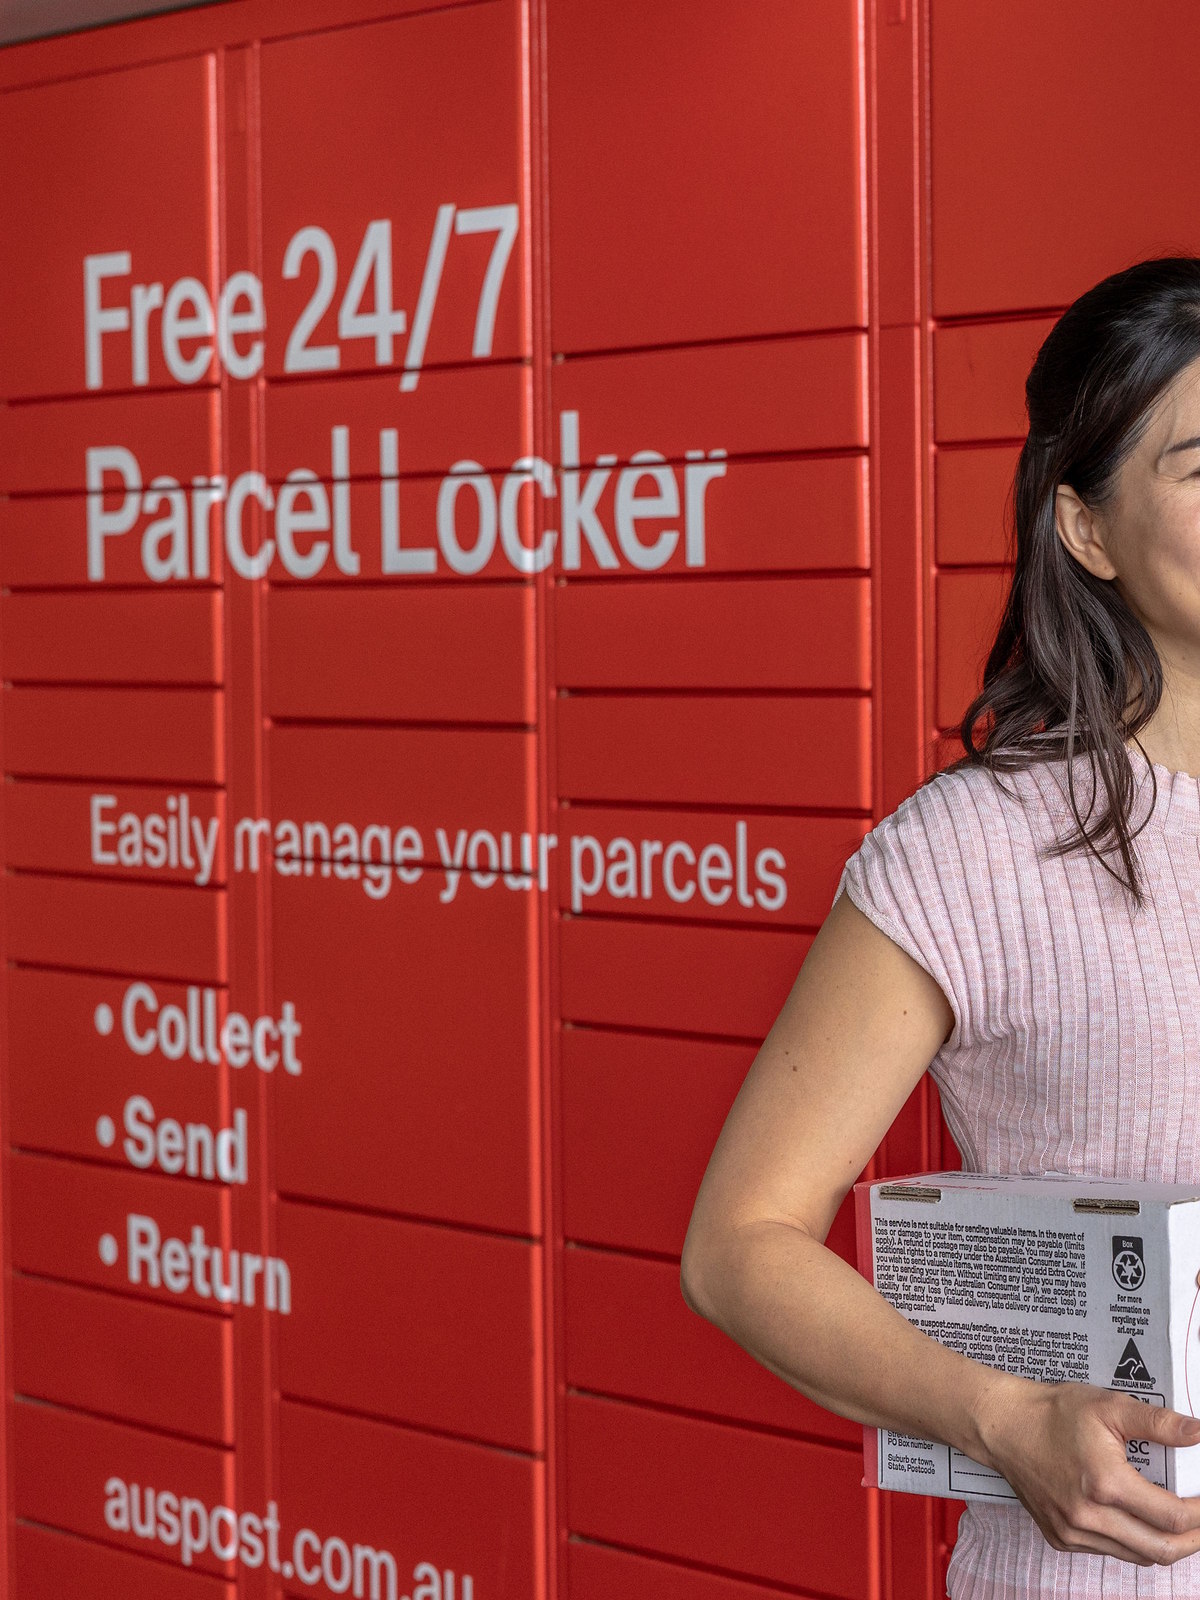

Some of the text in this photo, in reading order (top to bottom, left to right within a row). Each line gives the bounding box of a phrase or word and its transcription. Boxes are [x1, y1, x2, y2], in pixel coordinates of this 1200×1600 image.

[84, 204, 518, 391] Free 24/7
[87, 411, 727, 581] Parcel Locker
[91, 795, 788, 912] Easily manage your parcels
[122, 982, 302, 1075] Collect
[124, 1096, 248, 1184] Send
[875, 1218, 888, 1226] This
[889, 1220, 911, 1228] service
[911, 1221, 917, 1229] is
[955, 1224, 965, 1232] for
[1038, 1230, 1045, 1238] In
[1045, 1230, 1057, 1239] the
[1077, 1233, 1085, 1241] of
[875, 1227, 888, 1236] loss
[897, 1229, 923, 1240] damage
[924, 1231, 931, 1239] to
[932, 1233, 947, 1242] your
[966, 1236, 1010, 1245] compensation
[1011, 1239, 1026, 1248] may
[1026, 1238, 1036, 1247] be
[1036, 1240, 1063, 1250] payable
[897, 1238, 903, 1246] A
[903, 1239, 924, 1247] refund
[924, 1240, 932, 1248] of
[932, 1242, 958, 1252] postage
[959, 1244, 973, 1253] may
[973, 1244, 988, 1252] also
[988, 1245, 997, 1253] be
[1025, 1248, 1038, 1256] You
[1038, 1250, 1054, 1259] may
[1054, 1250, 1068, 1258] also
[1069, 1251, 1086, 1260] have
[1122, 1240, 1134, 1248] Box
[127, 1215, 291, 1315] Return
[906, 1248, 925, 1258] rights
[963, 1253, 982, 1261] under
[983, 1254, 994, 1262] the
[994, 1254, 1027, 1264] Australian
[1028, 1257, 1061, 1267] Consumer
[1080, 1261, 1086, 1269] If
[876, 1264, 891, 1273] prior
[892, 1265, 899, 1273] to
[925, 1269, 940, 1277] your
[957, 1270, 983, 1279] Without
[1008, 1276, 1021, 1285] any
[1021, 1275, 1040, 1285] rights
[1041, 1278, 1054, 1287] you
[1054, 1279, 1069, 1289] may
[1070, 1279, 1087, 1287] have
[877, 1273, 896, 1282] under
[896, 1274, 908, 1283] law
[941, 1278, 953, 1286] the
[953, 1279, 986, 1289] Australian
[987, 1282, 1021, 1292] Consumer
[1053, 1289, 1075, 1298] accept
[902, 1284, 912, 1292] for
[914, 1287, 926, 1296] any
[928, 1286, 941, 1295] loss
[1117, 1294, 1142, 1304] For more
[895, 1301, 913, 1312] being
[903, 1294, 925, 1303] related
[933, 1298, 945, 1307] any
[991, 1301, 1005, 1309] late
[1005, 1302, 1031, 1314] delivery
[1039, 1305, 1066, 1316] damage
[1066, 1307, 1074, 1315] to
[1075, 1309, 1088, 1319] any
[1110, 1304, 1142, 1314] information
[927, 1330, 940, 1338] and
[940, 1330, 973, 1341] Conditions
[993, 1336, 1019, 1345] services
[1052, 1340, 1061, 1348] for
[1062, 1342, 1089, 1353] tracking
[1009, 1327, 1021, 1335] ask
[1030, 1331, 1045, 1339] your
[1047, 1332, 1071, 1340] nearest
[1073, 1333, 1088, 1341] Post
[969, 1343, 993, 1353] options
[998, 1354, 1005, 1362] of
[1007, 1355, 1026, 1364] Extra
[1027, 1357, 1048, 1366] Cover
[1049, 1359, 1058, 1367] for
[1019, 1365, 1044, 1378] Privacy
[1067, 1370, 1089, 1379] Check
[1111, 1380, 1139, 1389] AUSTRALIAN
[888, 1438, 934, 1450] PO Box number
[1126, 1440, 1149, 1455] SC
[888, 1454, 909, 1463] Suburb
[918, 1457, 935, 1467] town,
[888, 1462, 935, 1475] State, Postcode
